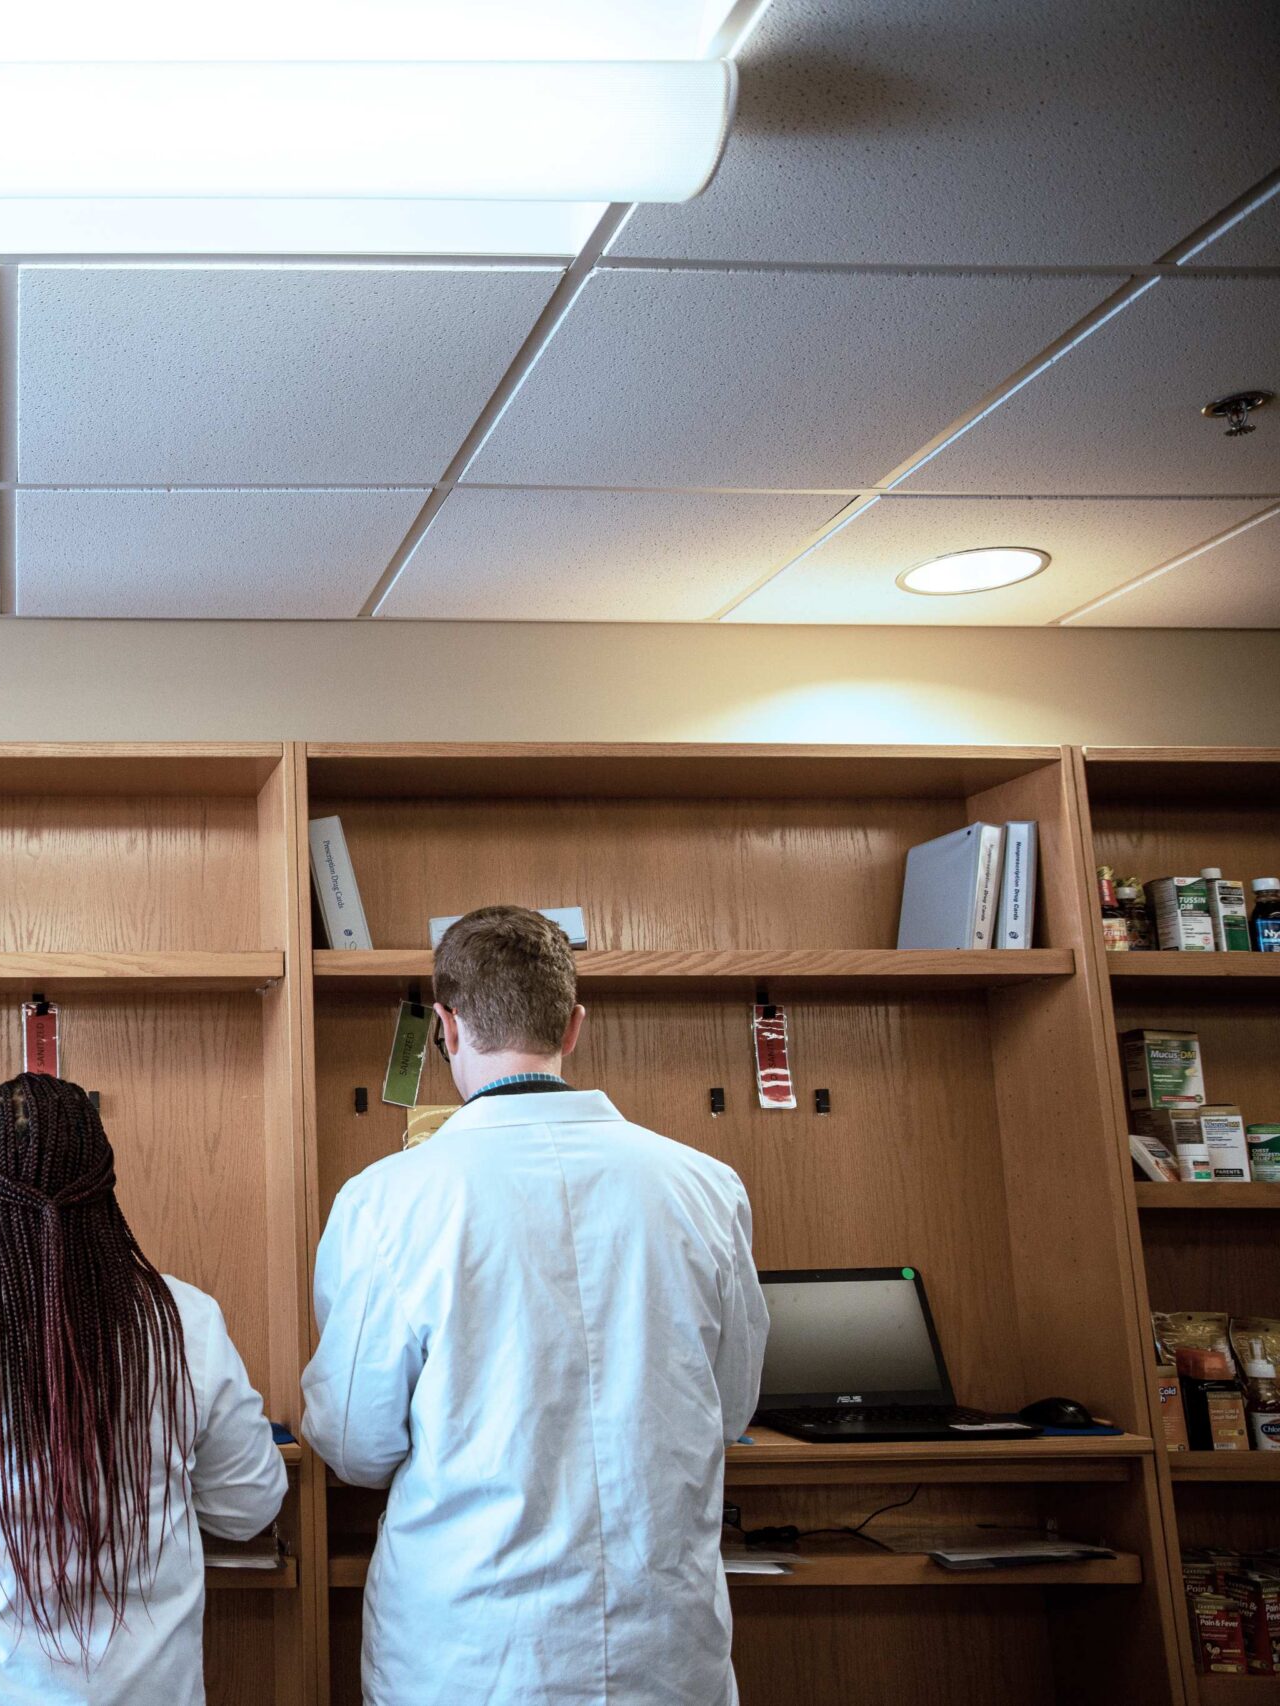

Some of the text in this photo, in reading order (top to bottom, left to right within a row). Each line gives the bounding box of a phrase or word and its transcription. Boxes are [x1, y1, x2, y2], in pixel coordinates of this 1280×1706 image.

[322, 840, 345, 910] Prescription Drug Cards
[980, 904, 988, 922] Cards
[1264, 929, 1280, 938] Ny
[37, 1023, 45, 1067] SANITIZED
[400, 1032, 415, 1076] SANITIZED
[1150, 1050, 1197, 1060] Mucus-DM
[1159, 1387, 1177, 1396] Cold
[836, 1395, 863, 1404] ASUS
[1262, 1425, 1280, 1433] Chlo
[1186, 1584, 1206, 1593] Pain
[1267, 1612, 1280, 1622] Feve
[1200, 1618, 1215, 1626] Pain
[1222, 1619, 1239, 1628] Fever
